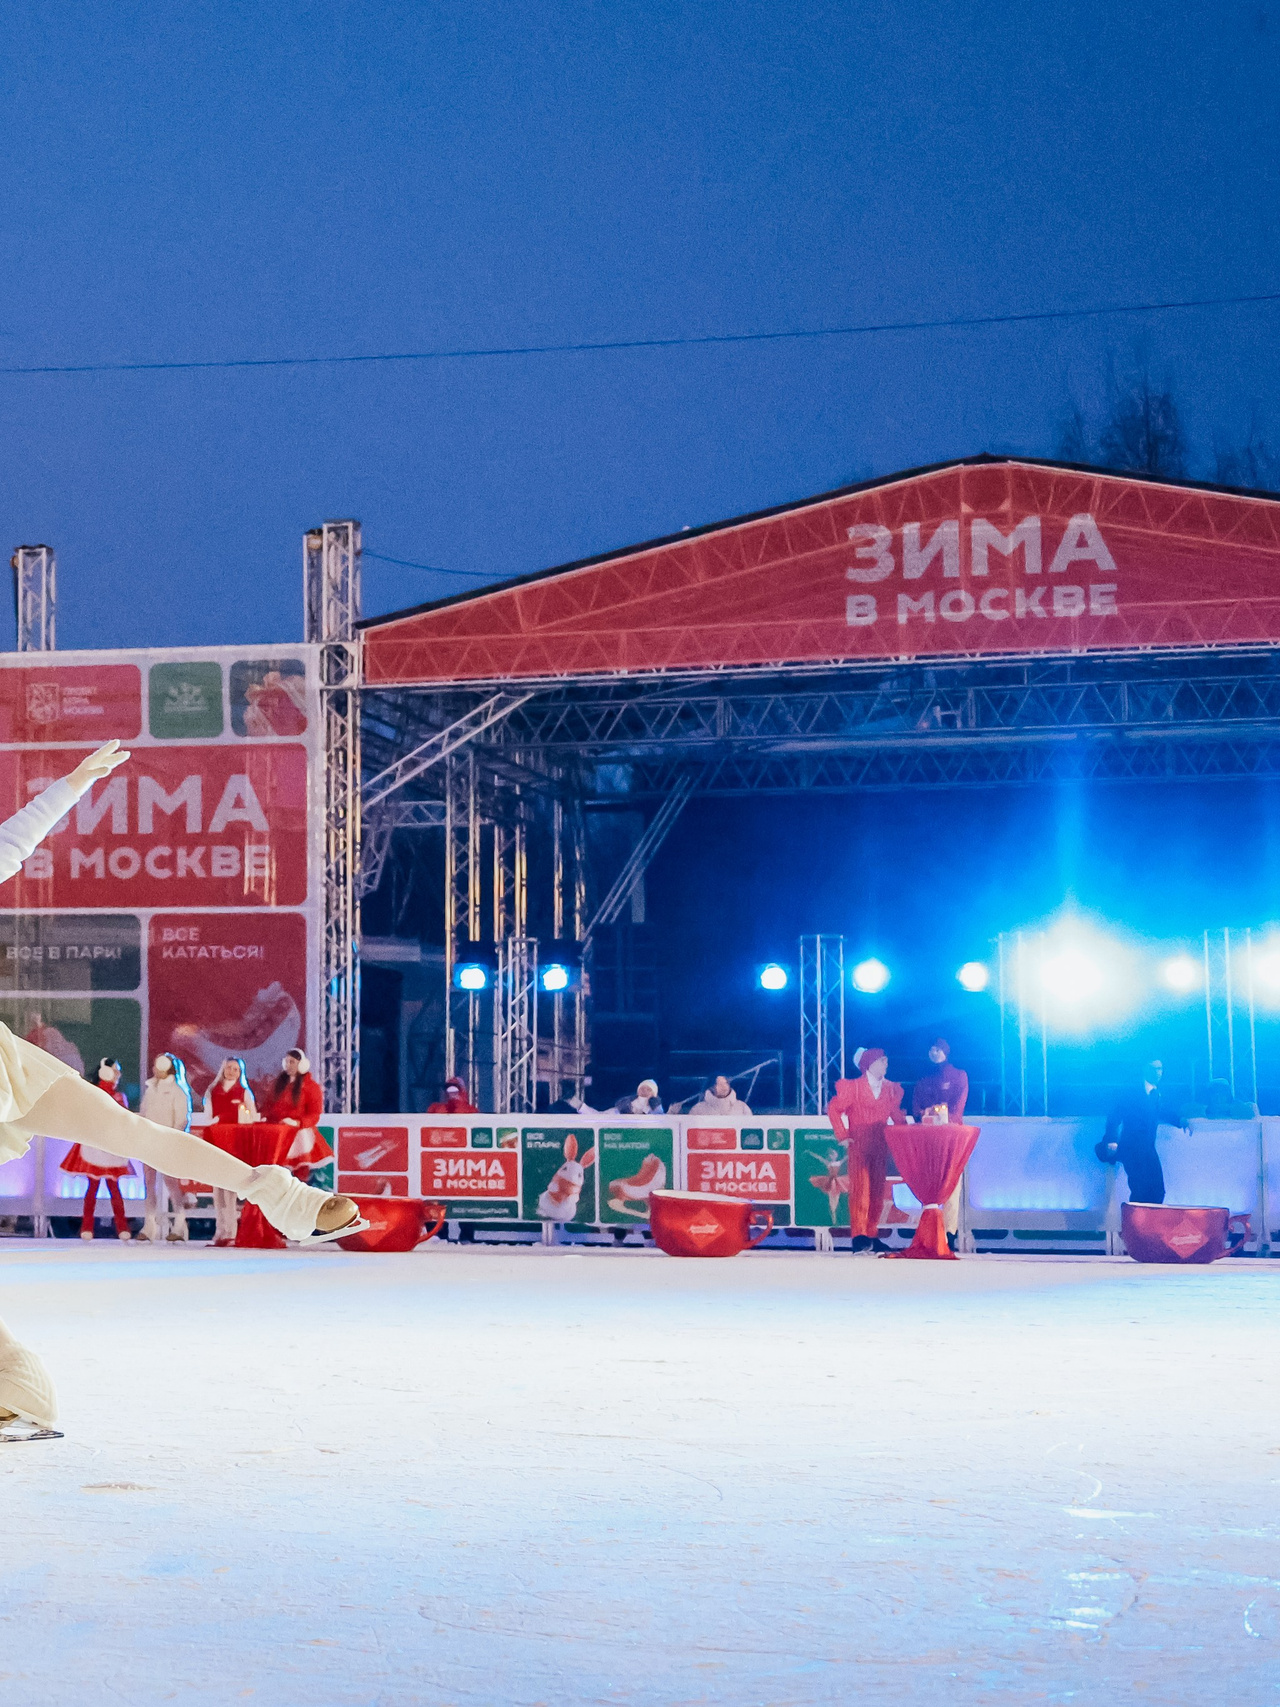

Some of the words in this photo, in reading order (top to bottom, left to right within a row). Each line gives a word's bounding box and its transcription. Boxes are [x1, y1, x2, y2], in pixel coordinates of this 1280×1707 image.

[846, 513, 1118, 582] ЗИМА
[846, 595, 878, 626] В
[897, 583, 1118, 624] МОСКВЕ
[24, 848, 54, 879] В
[70, 845, 270, 879] МОСКВЕ
[162, 927, 200, 941] ВСЕ
[6, 946, 43, 960] ВСЕ
[48, 946, 61, 960] В
[66, 946, 122, 959] ПАРК!
[162, 945, 264, 959] КАТАТЬСЯ!
[433, 1158, 505, 1177] ЗИМА
[701, 1161, 776, 1180] ЗИМА
[433, 1178, 443, 1189] В
[446, 1178, 506, 1190] МОСКВЕ
[701, 1182, 711, 1192] В
[715, 1181, 778, 1193] МОСКВЕ
